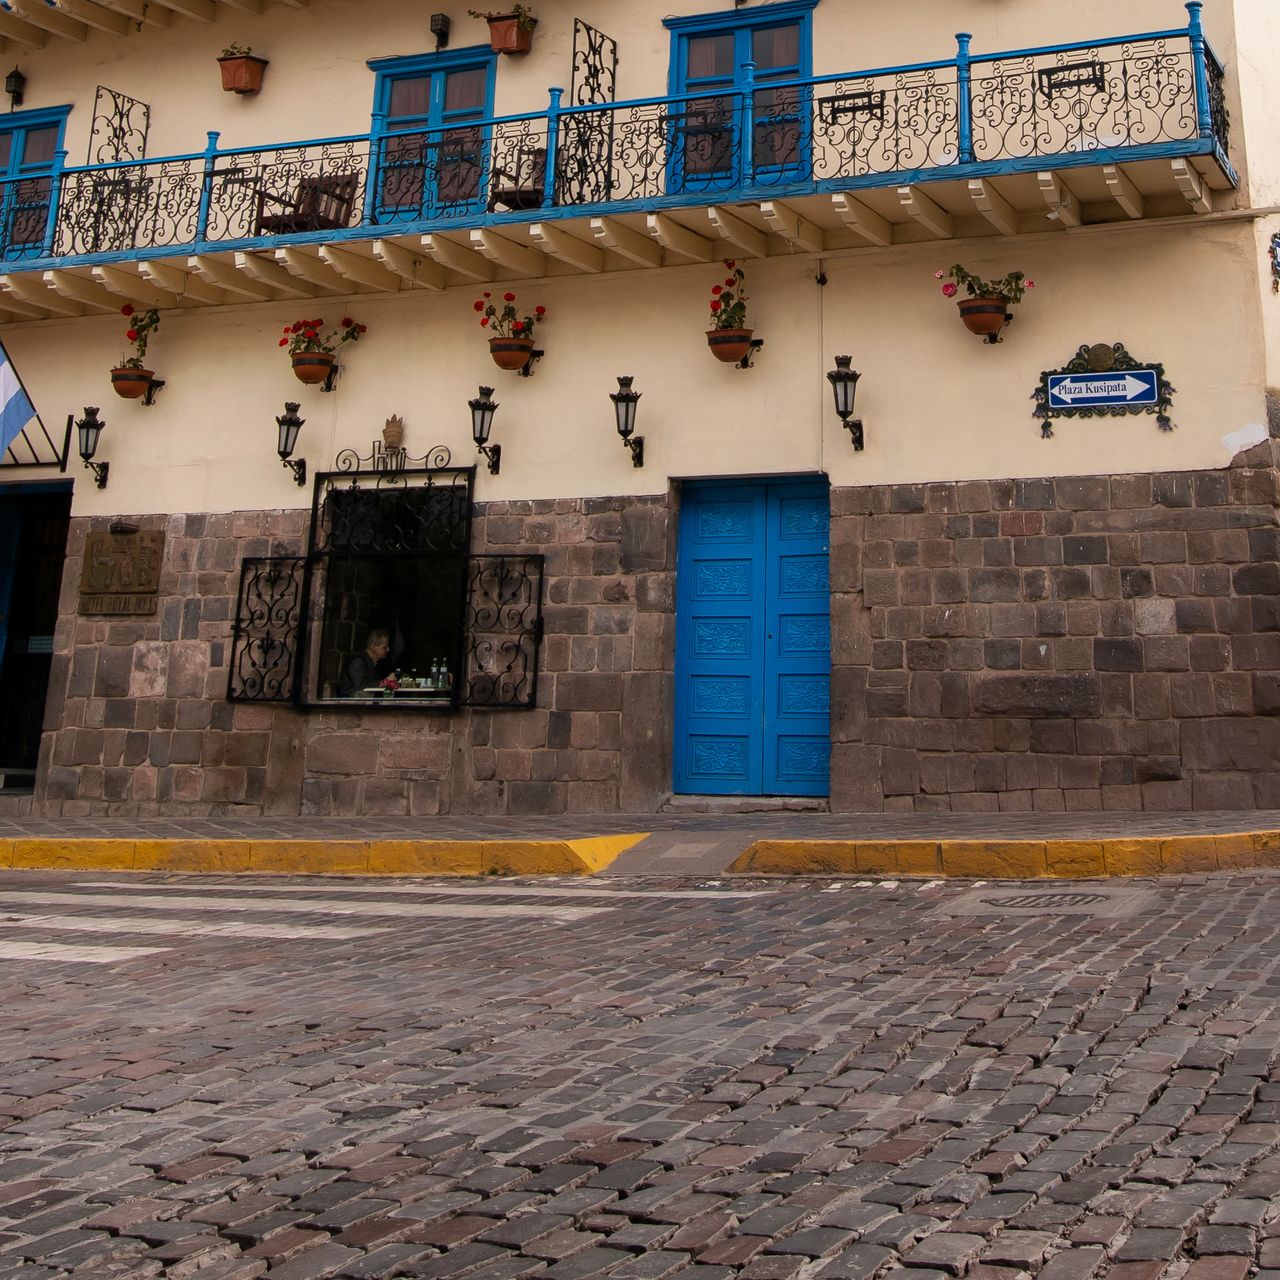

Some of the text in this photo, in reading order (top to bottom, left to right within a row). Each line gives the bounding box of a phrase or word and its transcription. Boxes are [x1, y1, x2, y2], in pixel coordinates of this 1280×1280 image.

[1058, 382, 1127, 395] Plaza Kusipata
[80, 596, 104, 613] HOTEL
[107, 596, 130, 612] ROYAL
